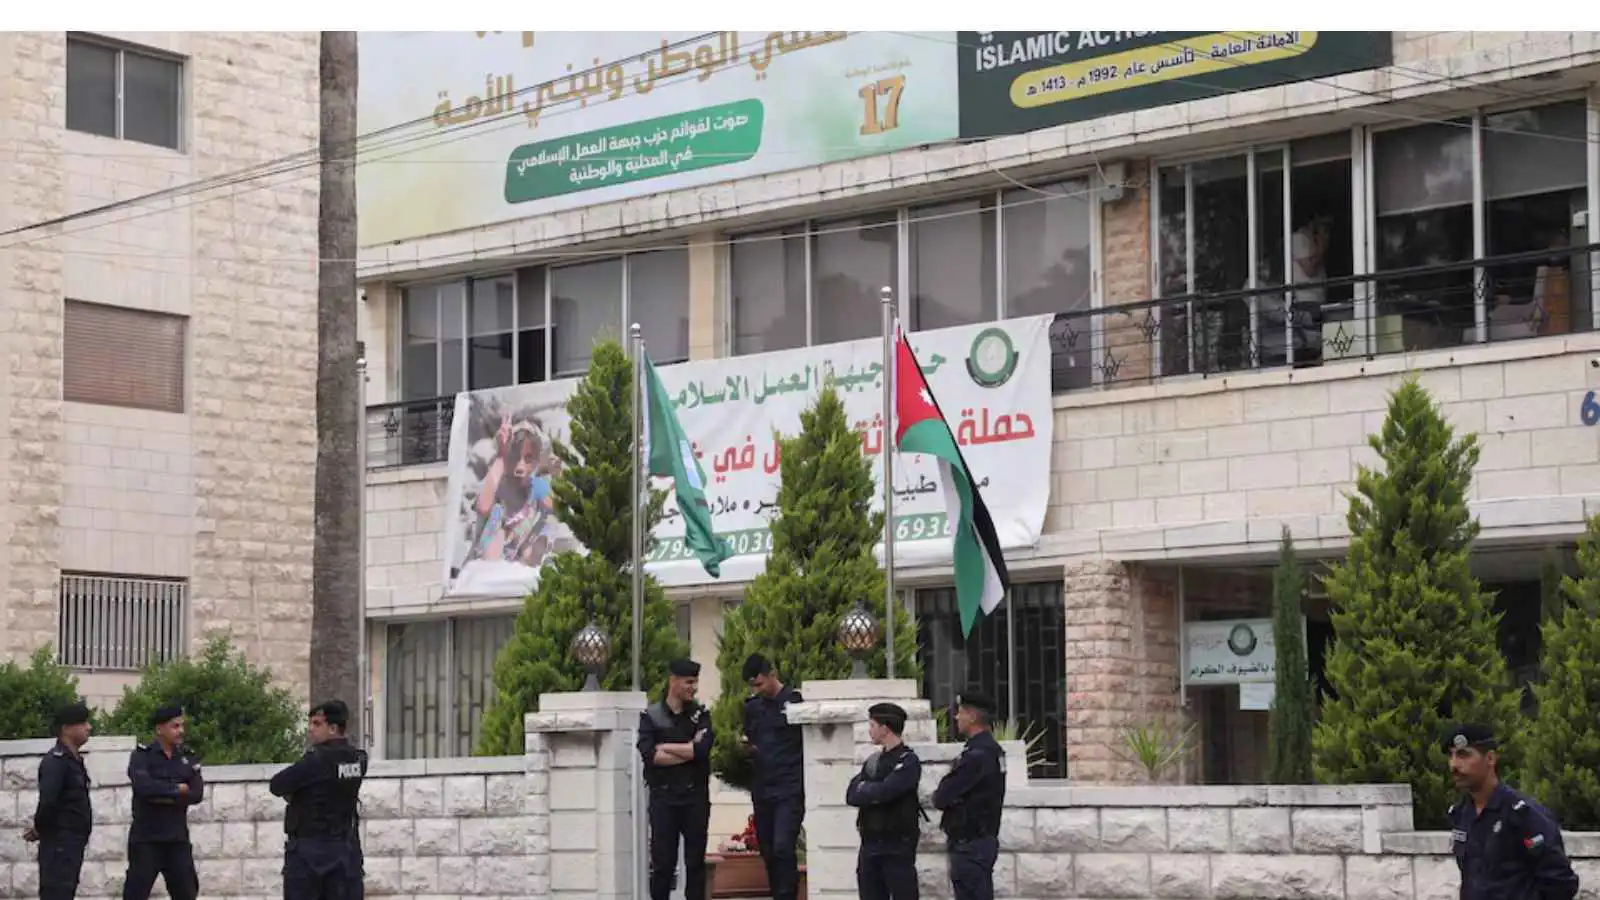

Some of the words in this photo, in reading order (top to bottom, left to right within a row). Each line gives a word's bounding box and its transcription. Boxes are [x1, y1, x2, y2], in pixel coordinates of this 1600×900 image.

[633, 31, 739, 94] الوطن
[975, 31, 1071, 73] ISLAMIC
[1150, 46, 1195, 75] تأسس
[1041, 76, 1067, 93] 1413
[1088, 66, 1118, 83] 1992
[1123, 62, 1146, 79] عام
[523, 57, 625, 129] ونبني
[858, 74, 906, 136] 17
[608, 134, 642, 152] جبهة
[643, 127, 669, 148] حزب
[671, 116, 711, 144] لقوائم
[516, 145, 570, 176] الإسلامي
[571, 136, 608, 161] العمل
[670, 144, 693, 171] في
[569, 159, 623, 185] والوطنية
[752, 362, 820, 406] العمل
[957, 408, 1035, 447] حملة
[713, 434, 755, 483] في
